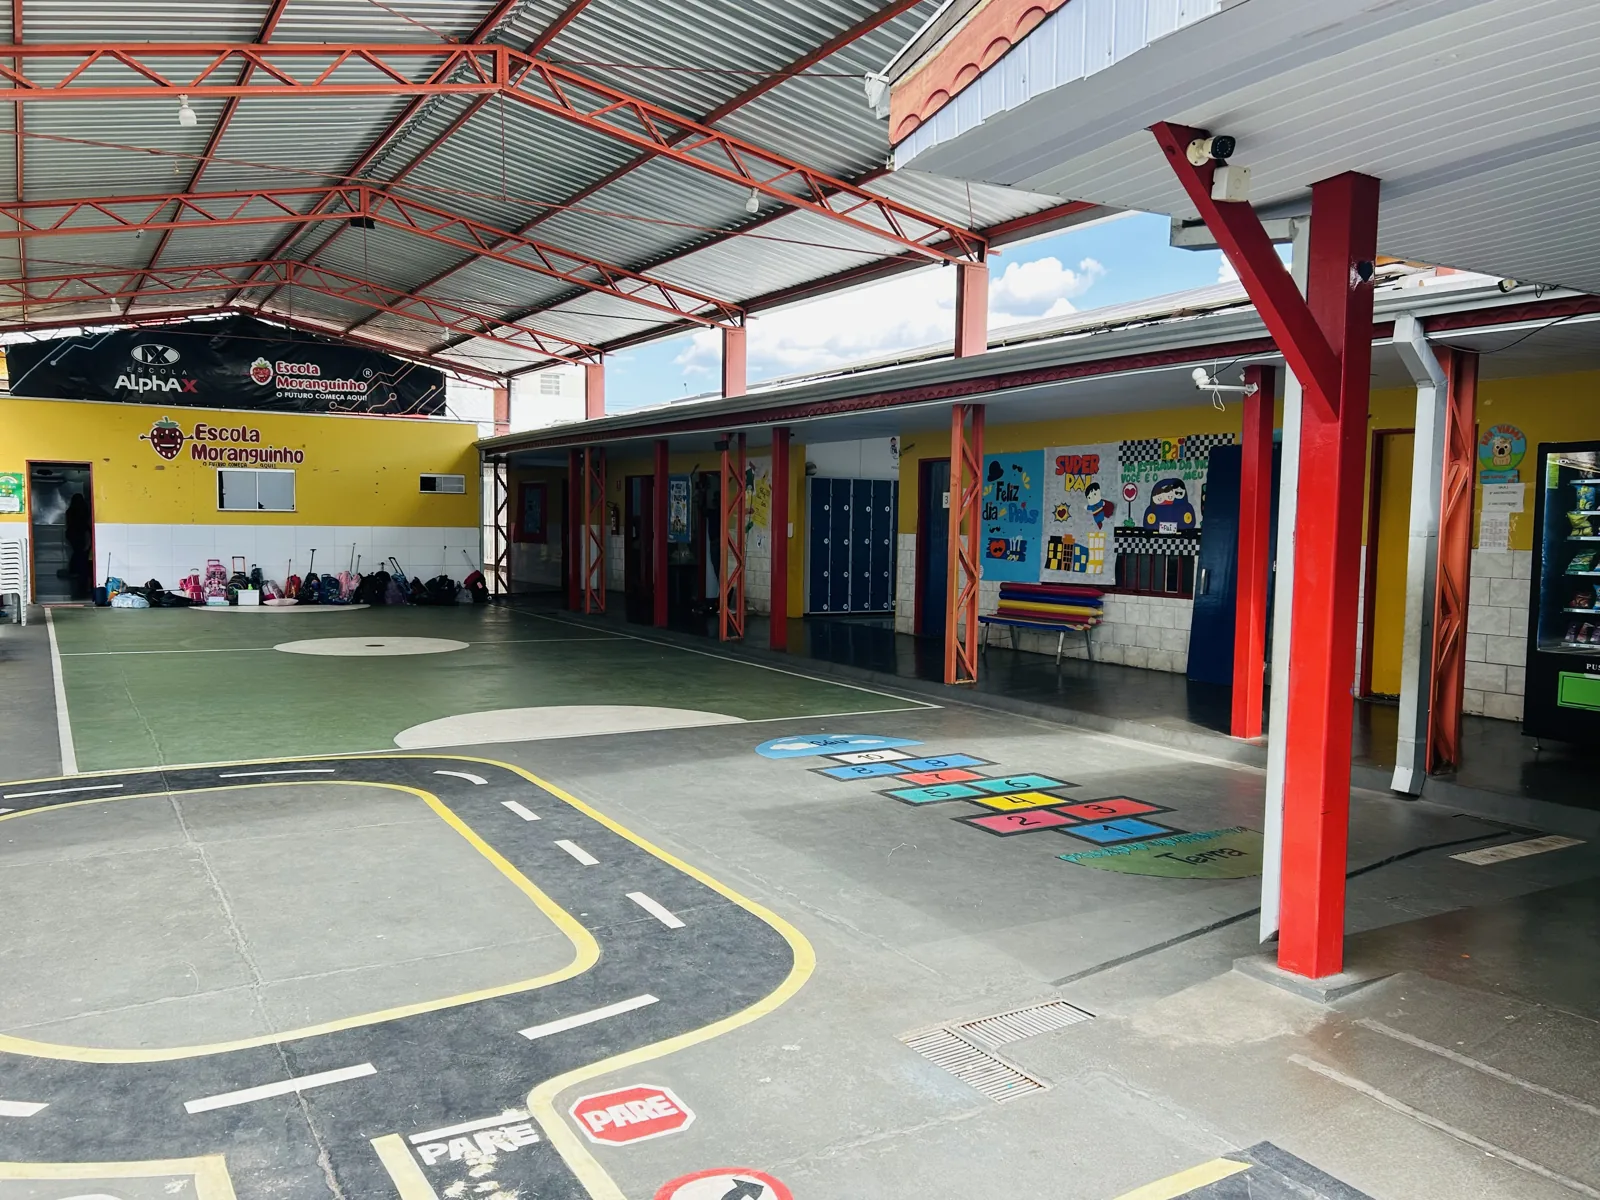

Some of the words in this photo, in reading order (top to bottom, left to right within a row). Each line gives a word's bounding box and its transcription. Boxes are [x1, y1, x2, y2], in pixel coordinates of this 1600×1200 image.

[127, 366, 187, 375] ESCOLA
[276, 361, 320, 375] Escola
[276, 376, 367, 392] Moranguinho
[315, 393, 345, 401] COMEÇA
[194, 423, 260, 443] Escola
[191, 443, 304, 465] Moranguinho
[1161, 438, 1185, 459] Pai
[1055, 454, 1099, 475] SUPER
[996, 481, 1019, 502] Feliz
[982, 502, 998, 521] dia
[925, 759, 948, 767] 9
[925, 773, 945, 781] 7
[922, 788, 951, 798] 5
[1004, 779, 1031, 789] 6
[1003, 796, 1036, 805] 4
[1007, 816, 1041, 826] 2
[1084, 804, 1117, 814] 3
[1103, 824, 1134, 835] 1
[1154, 847, 1249, 866] Terra
[582, 1095, 679, 1132] PARE
[417, 1123, 539, 1166] PARE
